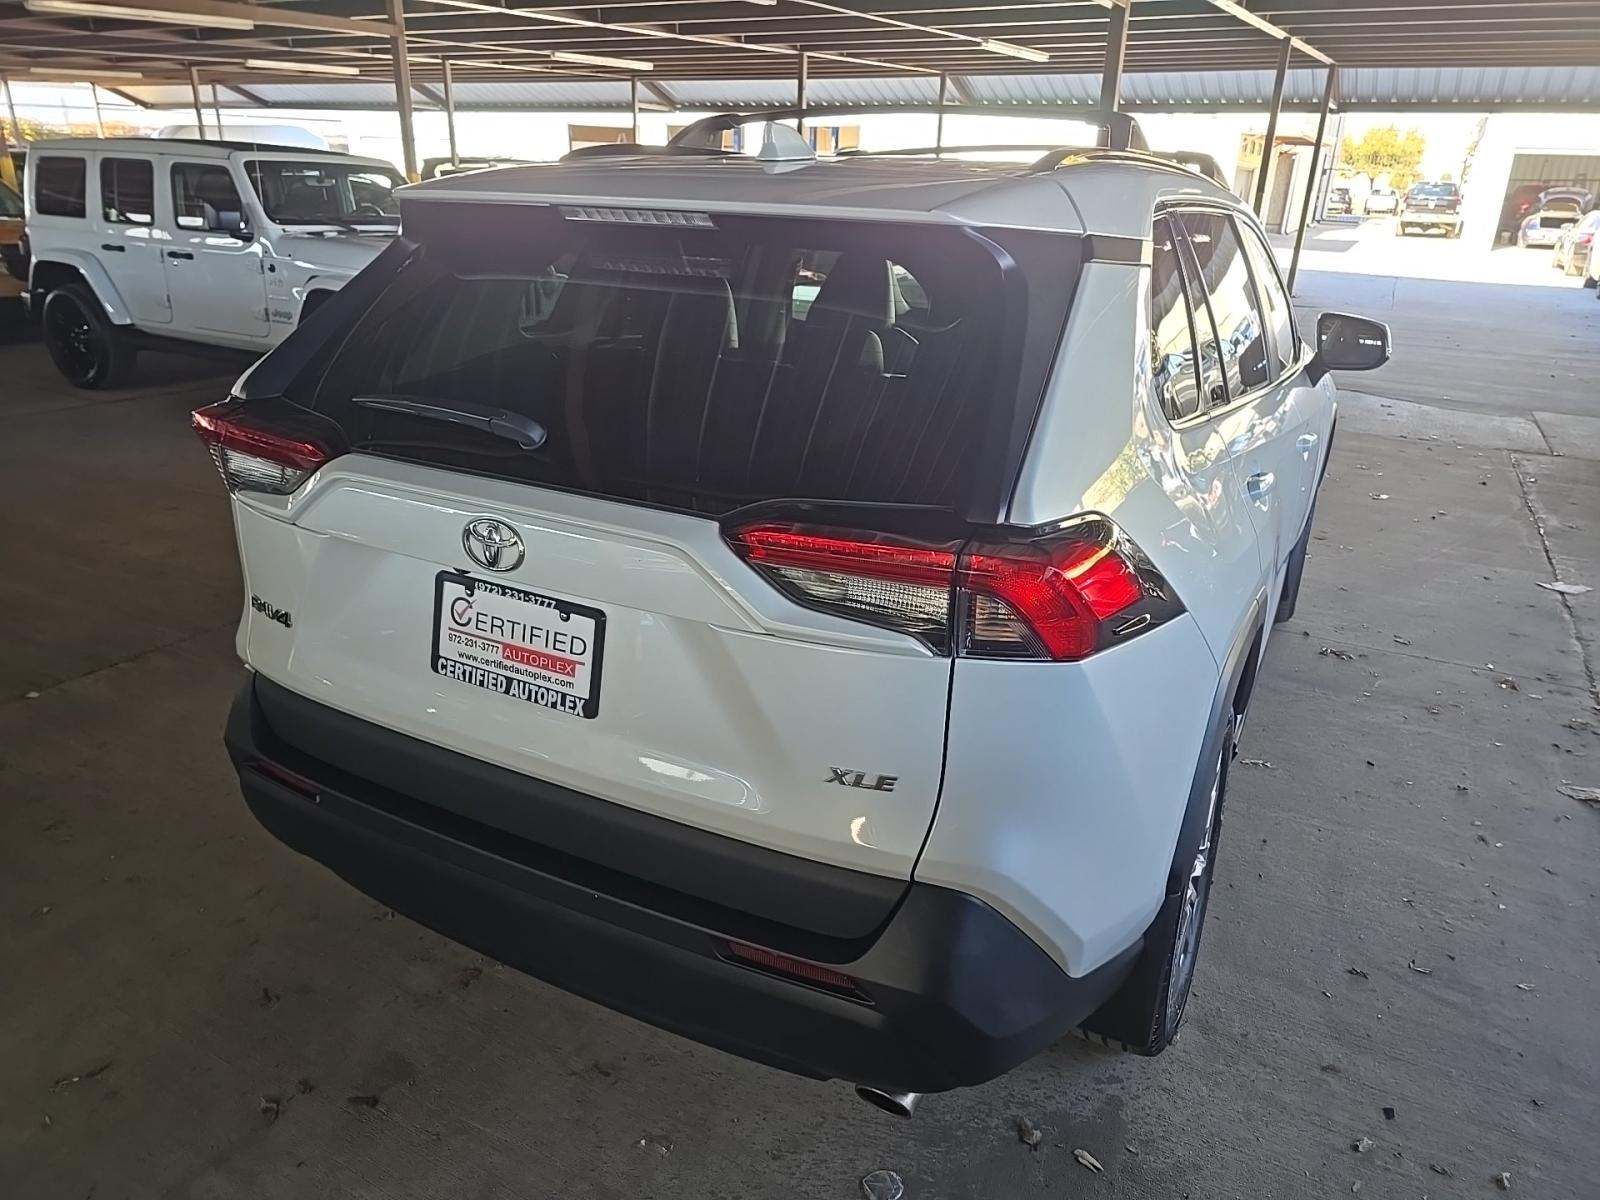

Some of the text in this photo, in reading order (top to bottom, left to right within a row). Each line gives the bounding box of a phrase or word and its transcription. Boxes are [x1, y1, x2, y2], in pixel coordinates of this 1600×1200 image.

[451, 597, 587, 656] CERTIFIED
[448, 633, 574, 675] 972-231-3777 AUTOPLEX
[457, 650, 575, 690] www.certifiedautoplex.com
[437, 657, 586, 717] CERTIFIED AUTOPLEX
[823, 766, 899, 792] XLE
